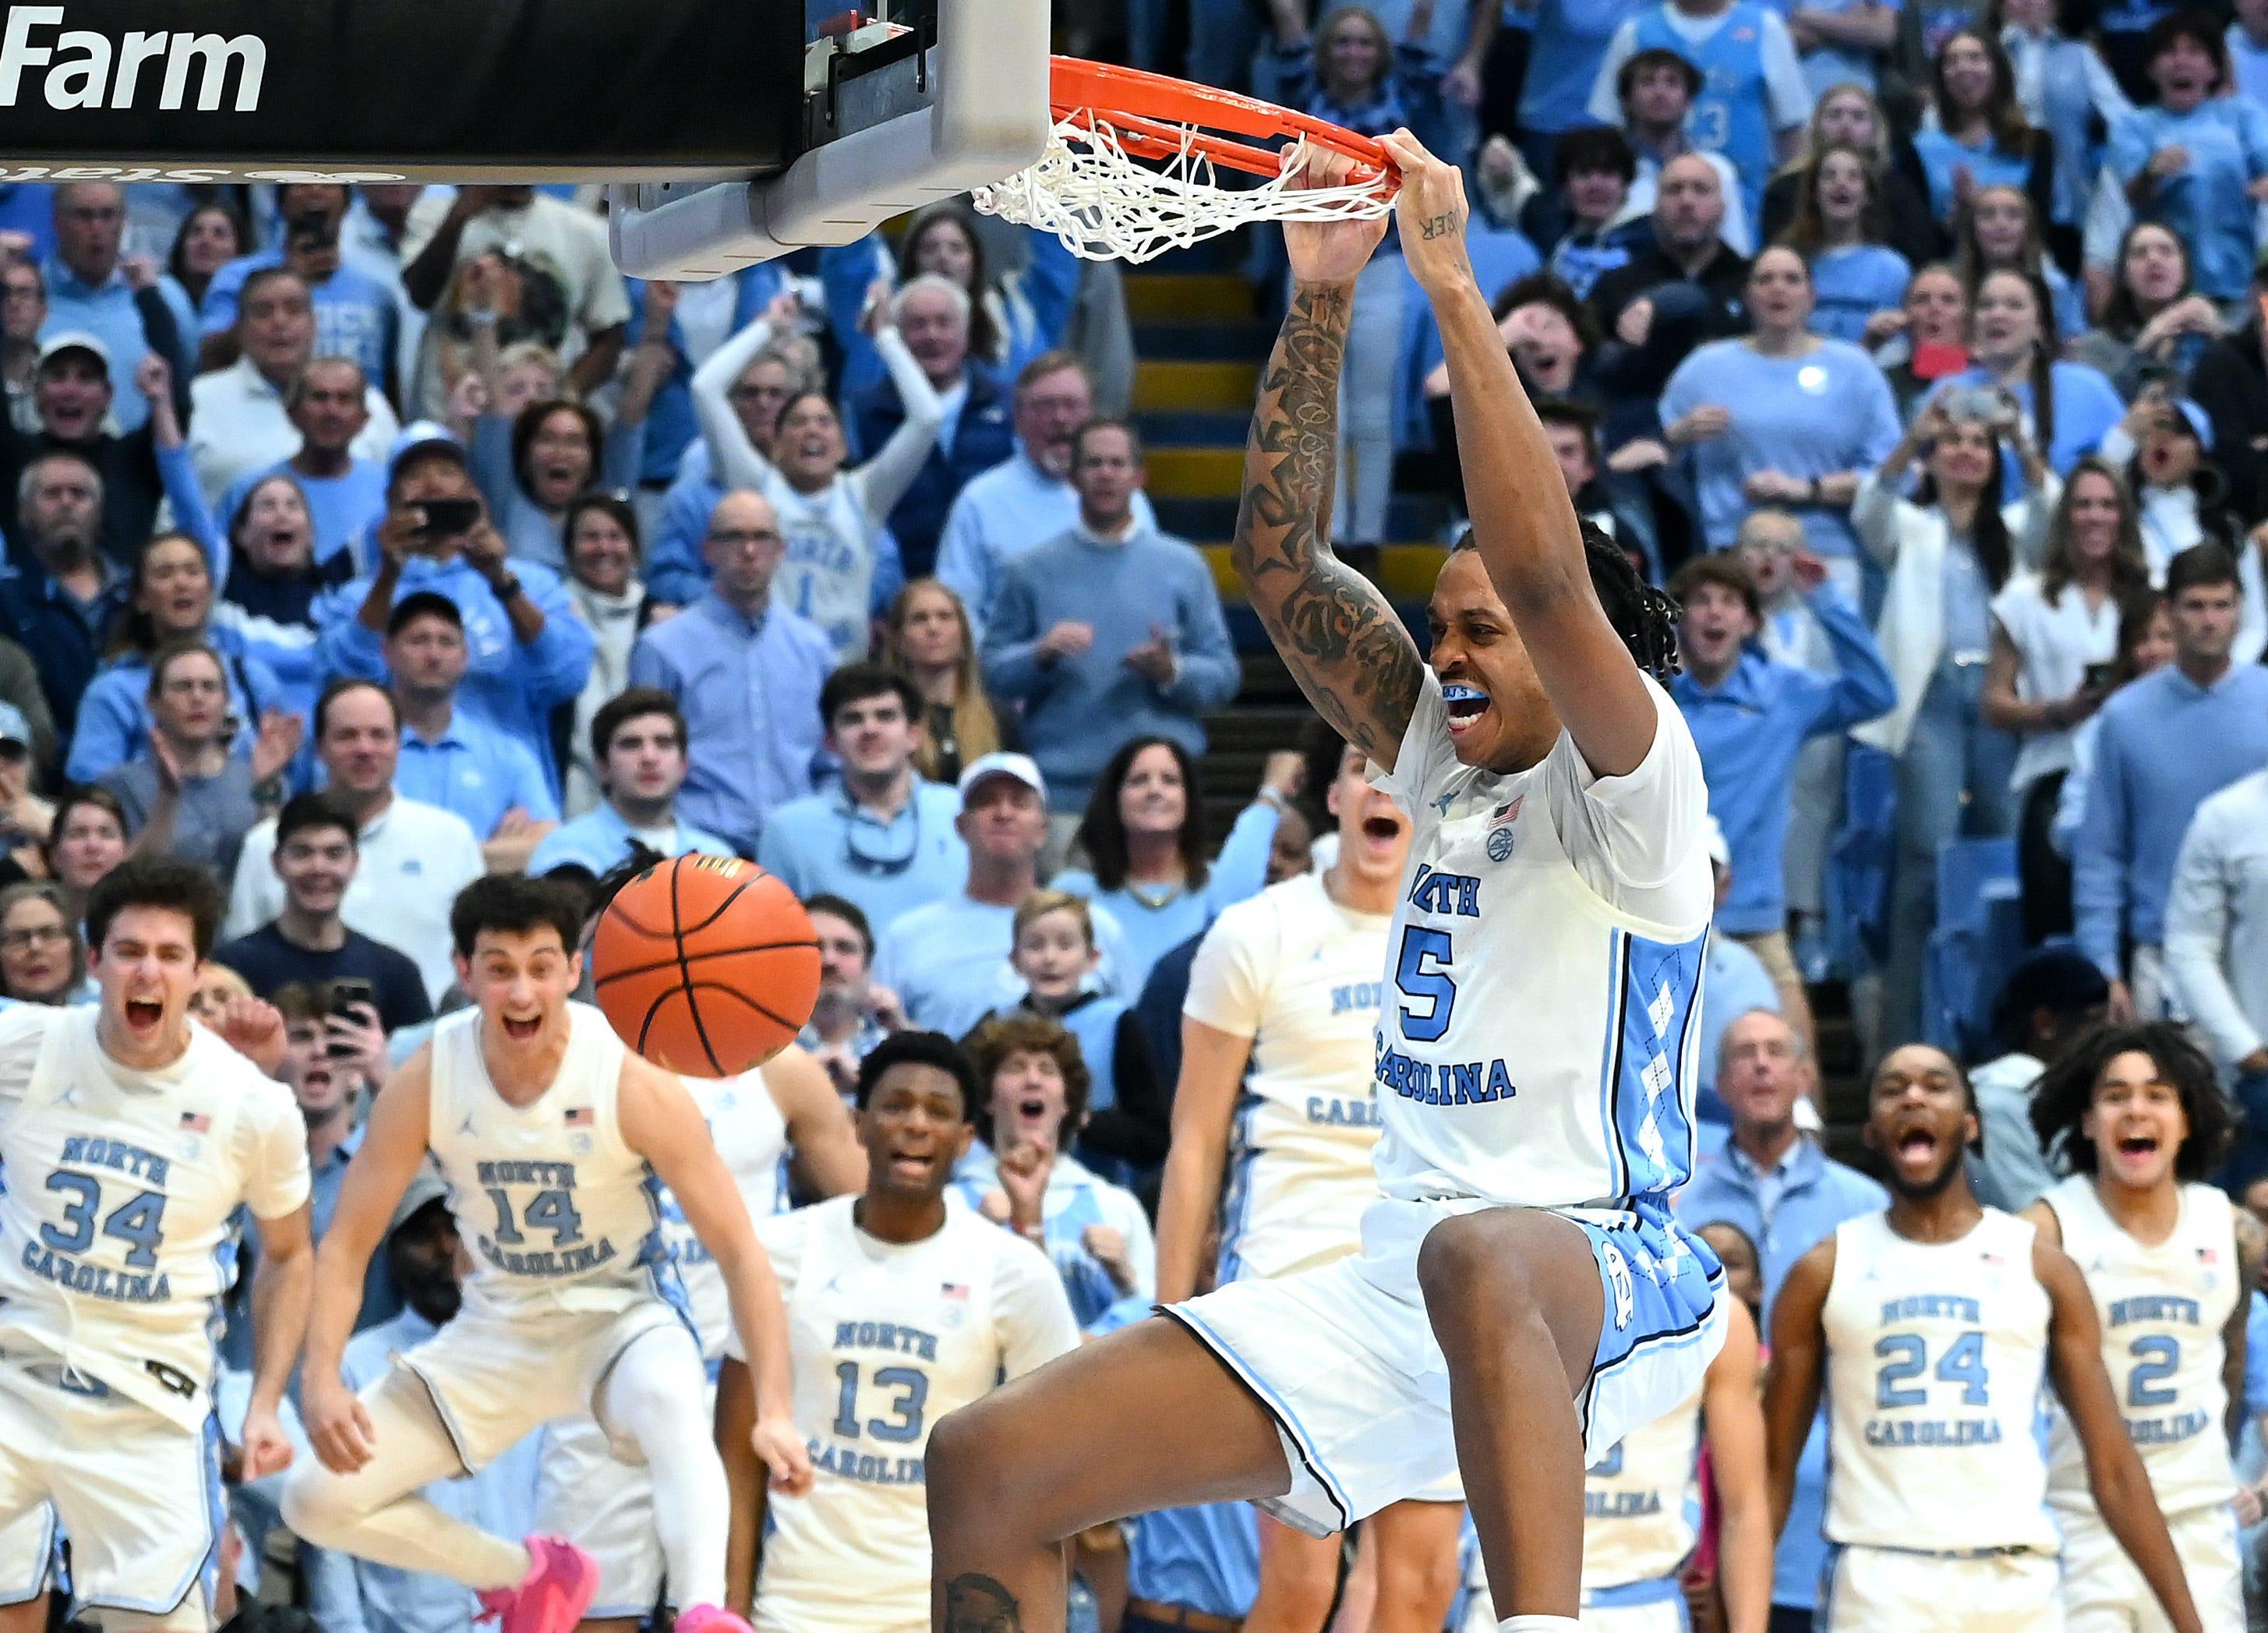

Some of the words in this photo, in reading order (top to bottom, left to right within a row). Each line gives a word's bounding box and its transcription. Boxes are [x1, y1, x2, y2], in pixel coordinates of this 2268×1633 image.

[0, 6, 267, 111] Farm
[0, 168, 232, 182] Stat
[1395, 924, 1457, 1042] 5
[61, 1137, 169, 1186] NORTH
[477, 1161, 576, 1189] NORTH
[40, 1171, 168, 1268] 34
[486, 1189, 583, 1245] 14
[22, 1240, 171, 1303] CAROLINA
[478, 1234, 616, 1277] CAROLINA
[1880, 1294, 1980, 1326] NORTH
[2109, 1295, 2200, 1327] NORTH
[833, 1322, 938, 1363] NORTH
[1874, 1331, 1989, 1409] 24
[2128, 1335, 2179, 1406] 2
[833, 1360, 928, 1442] 13
[1864, 1418, 2002, 1447] CAROLINA
[807, 1437, 926, 1485] CAROLIN
